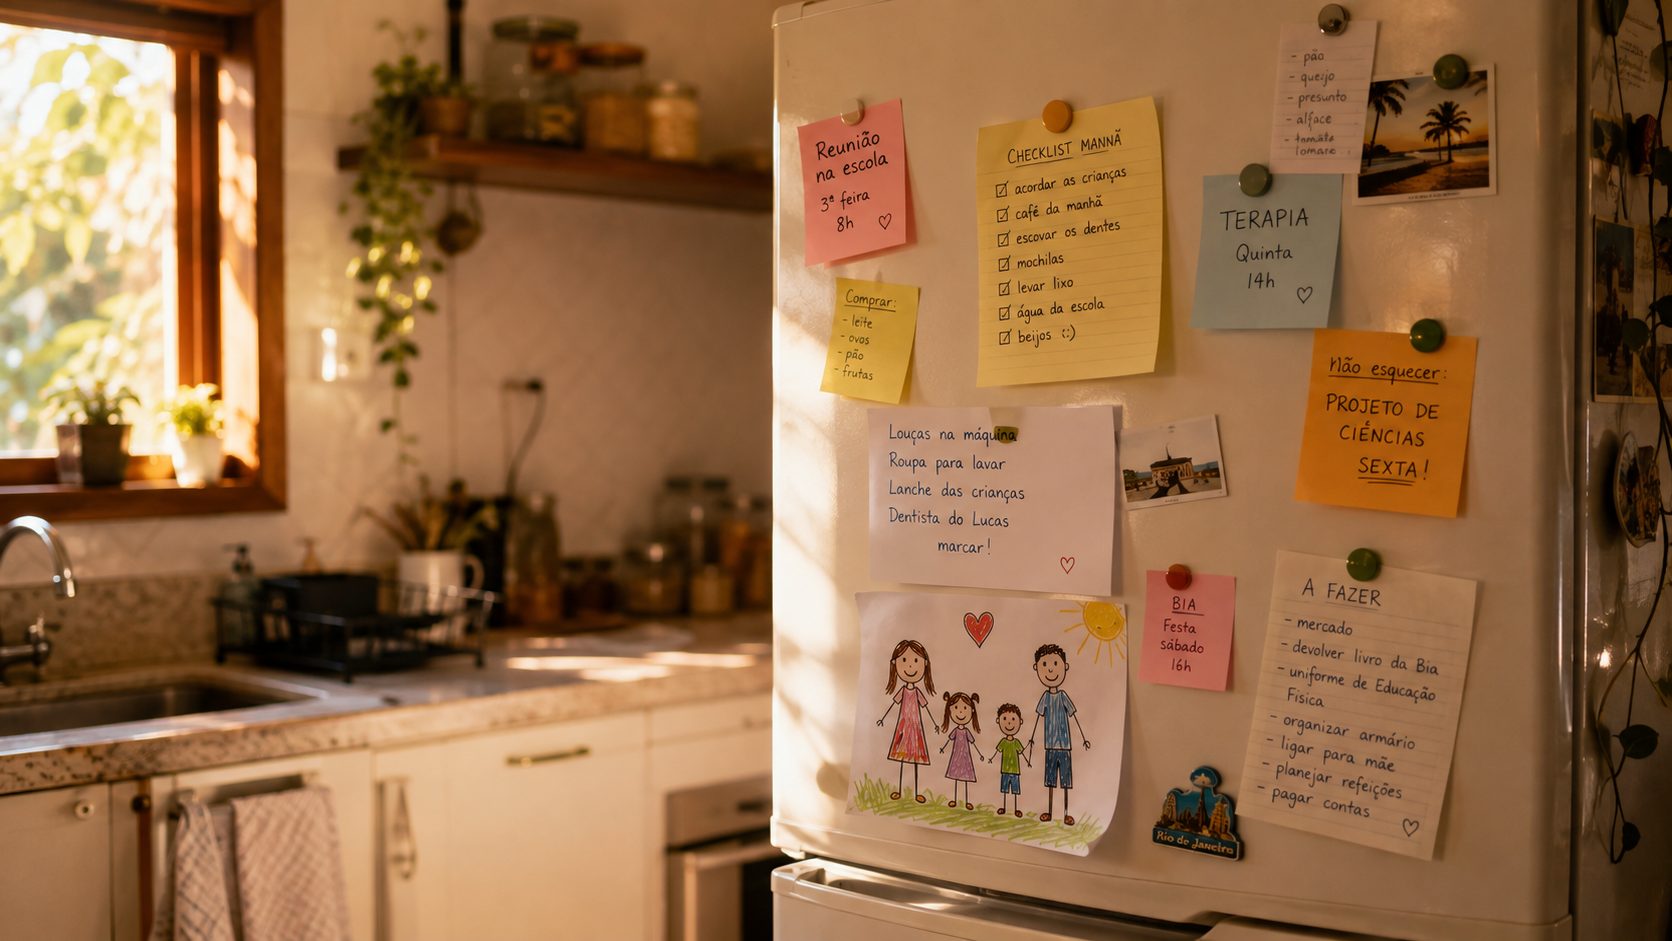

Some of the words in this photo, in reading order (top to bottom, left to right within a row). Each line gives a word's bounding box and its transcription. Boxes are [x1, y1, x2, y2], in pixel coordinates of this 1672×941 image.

[1303, 49, 1325, 67] pão
[1300, 71, 1335, 88] queijo
[1298, 90, 1347, 109] presunto
[1296, 111, 1332, 131] alface
[815, 130, 881, 160] Reunião
[1007, 141, 1073, 165] CHECKLIST
[816, 169, 836, 184] na
[843, 153, 888, 176] escola
[1014, 178, 1057, 196] acordar
[1063, 175, 1076, 187] as
[1082, 166, 1127, 184] crianças
[840, 191, 870, 210] feira
[1015, 205, 1040, 222] café
[1046, 201, 1060, 215] da
[1066, 195, 1104, 210] manhã
[837, 217, 854, 232] 8h
[1219, 207, 1309, 231] TERAPIA
[1016, 229, 1057, 245] escovar
[1064, 226, 1077, 238] os
[1083, 219, 1121, 235] dentes
[1017, 252, 1065, 268] mochilas
[1236, 243, 1293, 263] Quinta
[1017, 280, 1045, 294] levar
[1053, 276, 1074, 290] lixo
[1248, 272, 1275, 289] 14h
[845, 289, 897, 311] Comprar:
[1017, 304, 1044, 324] água
[1050, 301, 1064, 314] da
[1070, 296, 1105, 312] escola
[852, 316, 873, 329] leite
[849, 334, 870, 345] ovos
[1018, 329, 1052, 348] beijos
[845, 348, 864, 362] pão
[842, 367, 873, 381] frutas
[1371, 363, 1447, 385] esquecer:
[1326, 392, 1404, 416] PROJETO
[1415, 402, 1441, 420] DE
[889, 424, 931, 445] Louças
[939, 429, 955, 441] na
[963, 427, 1018, 447] máquina
[888, 452, 927, 474] Roupa
[936, 458, 964, 475] para
[972, 454, 1007, 471] lavar
[888, 480, 932, 497] Lanche
[941, 482, 964, 498] das
[971, 486, 1025, 503] crianças
[888, 507, 940, 525] Dentista
[948, 510, 964, 526] do
[972, 511, 1009, 529] Lucas
[937, 538, 992, 556] marcar!
[1301, 577, 1315, 597] A
[1327, 582, 1382, 607] FAZER
[1172, 595, 1197, 611] BIA
[1163, 618, 1197, 634] Festa
[1297, 617, 1353, 636] mercado
[1160, 638, 1204, 654] sábado
[1171, 658, 1192, 672] 16h
[1292, 640, 1344, 660] devolver
[1354, 648, 1382, 667] livro
[1390, 655, 1408, 671] da
[1415, 657, 1439, 676] Bia
[1289, 665, 1345, 687] uniforme
[1352, 674, 1368, 690] de
[1375, 677, 1436, 704] Educação
[1283, 715, 1350, 735] organizar
[1359, 731, 1416, 750] armário
[1280, 735, 1314, 760] ligar
[1322, 746, 1355, 764] para
[1365, 756, 1396, 772] mãe
[1275, 762, 1333, 788] planejar
[1341, 774, 1402, 800] refeições
[1271, 787, 1313, 809] pagar
[1322, 797, 1371, 818] contas
[1156, 831, 1175, 843] Rio
[1176, 835, 1190, 845] de
